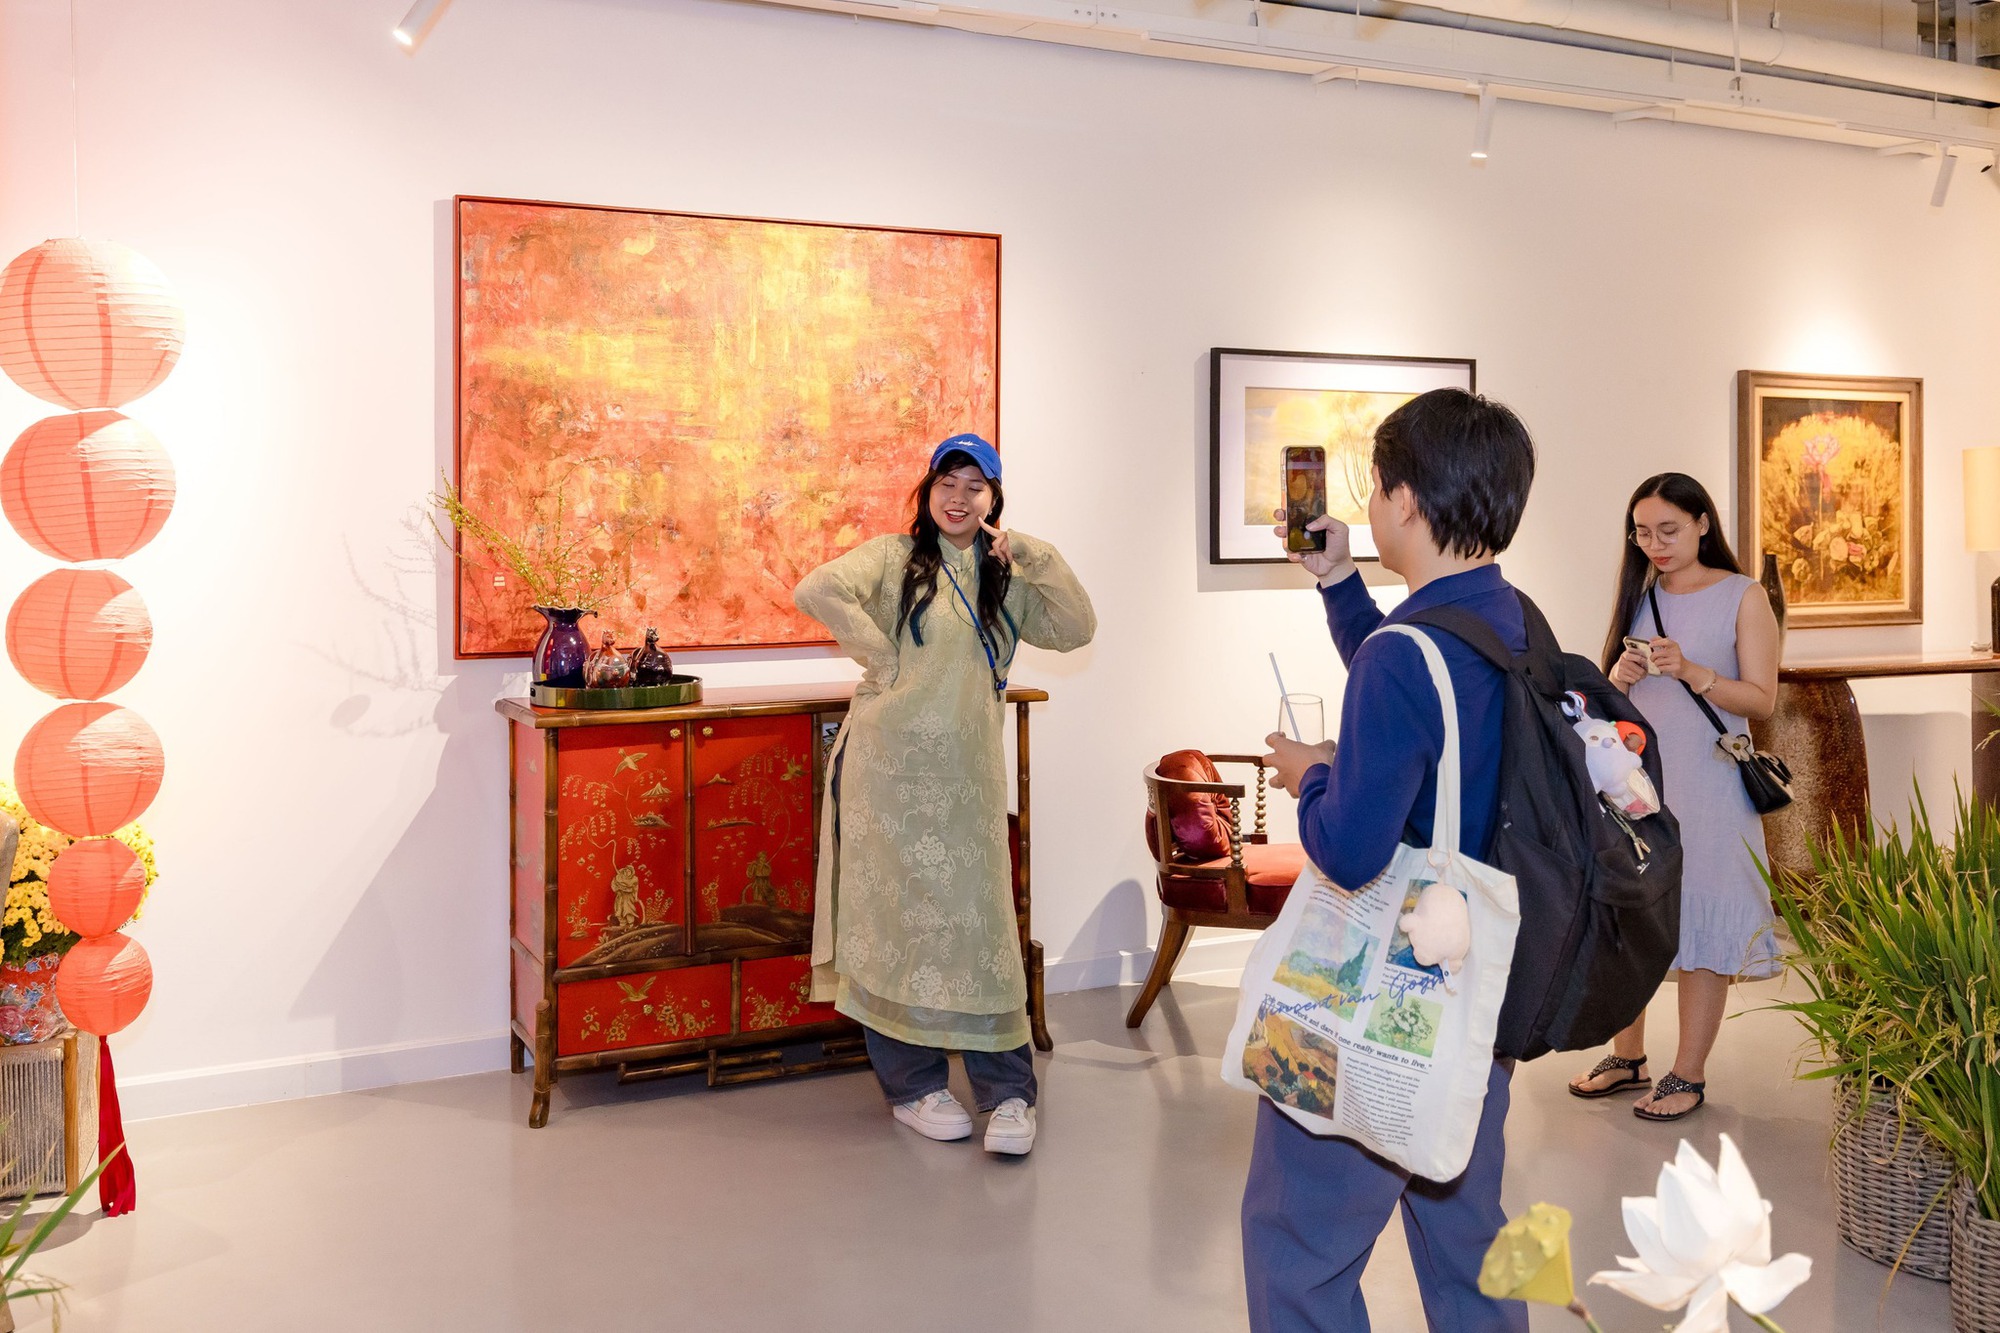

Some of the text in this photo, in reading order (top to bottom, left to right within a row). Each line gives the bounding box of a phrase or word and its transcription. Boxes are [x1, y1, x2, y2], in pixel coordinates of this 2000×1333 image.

[1340, 992, 1381, 1006] van
[1352, 1041, 1375, 1055] really
[1376, 1049, 1399, 1061] wants
[1401, 1056, 1409, 1064] to
